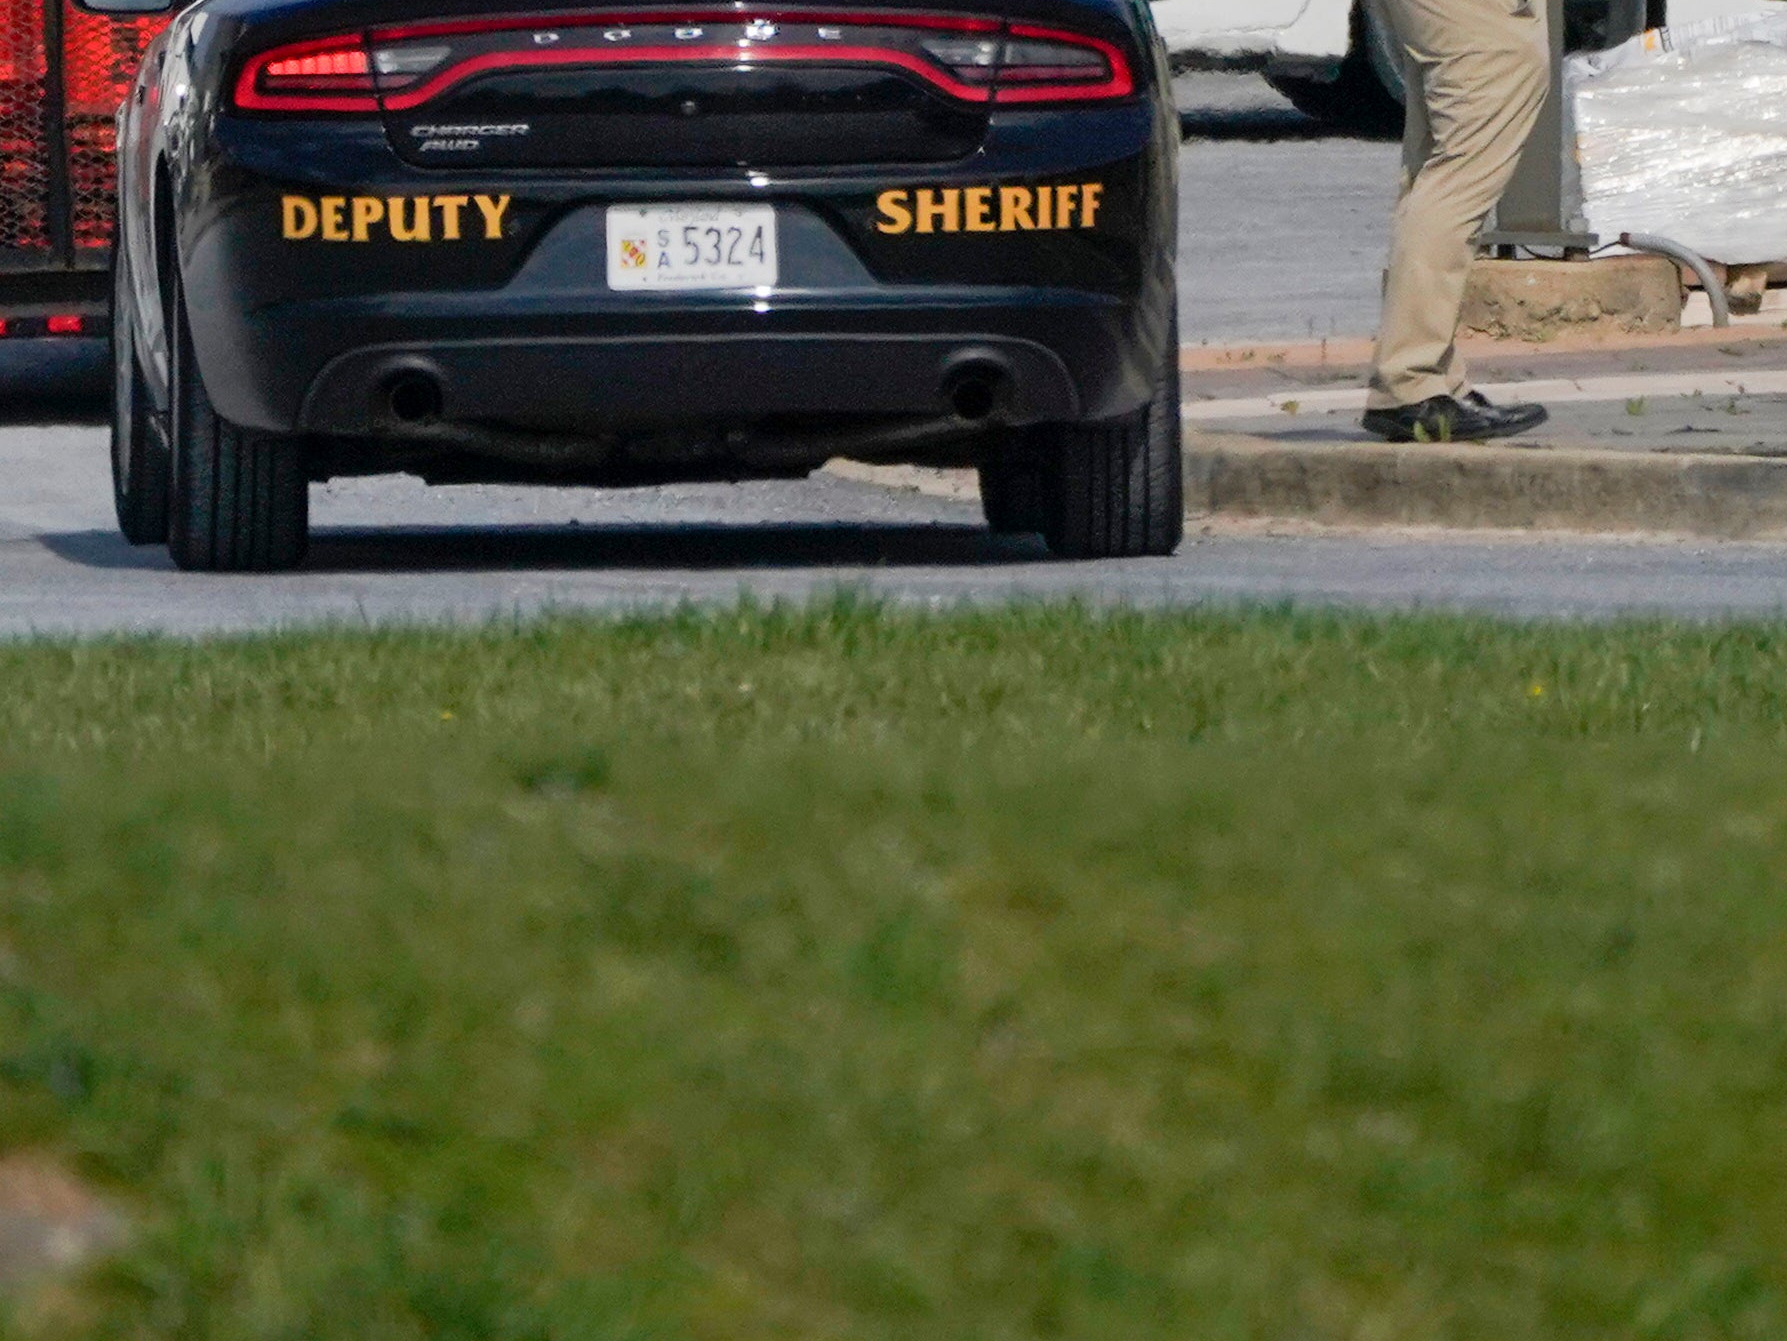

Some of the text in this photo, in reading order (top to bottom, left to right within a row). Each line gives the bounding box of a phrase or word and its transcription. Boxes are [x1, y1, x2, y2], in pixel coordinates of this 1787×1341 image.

[281, 194, 511, 242] DEPUTY
[875, 182, 1104, 234] SHERIFF
[682, 224, 766, 266] 5324
